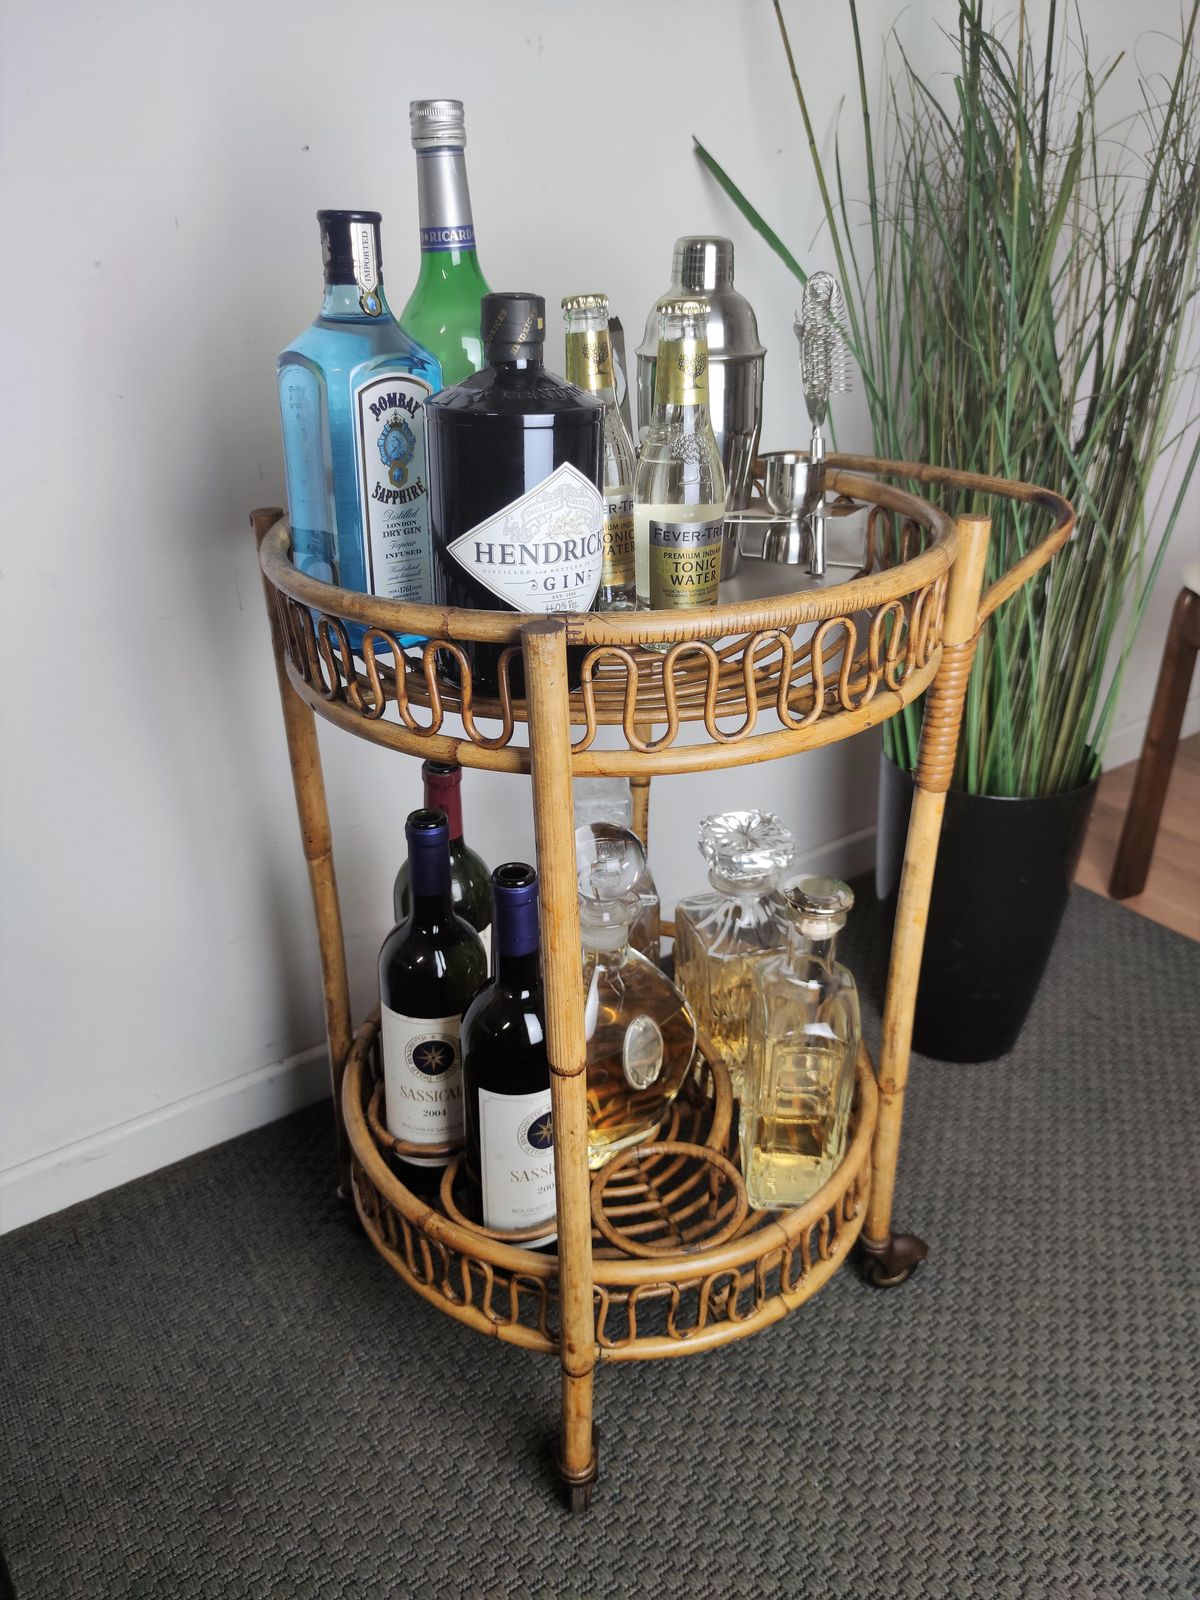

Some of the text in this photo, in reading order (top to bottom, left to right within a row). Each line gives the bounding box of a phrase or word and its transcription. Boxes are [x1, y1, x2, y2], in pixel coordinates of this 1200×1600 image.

[429, 229, 472, 243] RICARD
[361, 230, 372, 282] IMPORTED
[369, 392, 421, 421] BOMBAY
[371, 477, 426, 504] SAPPHIRE
[382, 507, 420, 522] Distilled
[386, 519, 417, 529] LONDON
[383, 526, 422, 539] DRY GIN
[390, 540, 416, 551] Vapour
[602, 541, 635, 555] ATER
[385, 549, 422, 559] INFUSED
[663, 551, 701, 560] PREMIUM
[672, 558, 717, 573] TONIC
[543, 571, 586, 591] GIN
[670, 570, 717, 586] WATER
[400, 585, 412, 593] 1761
[423, 1108, 446, 1117] 2004
[510, 1163, 554, 1183] SASSI
